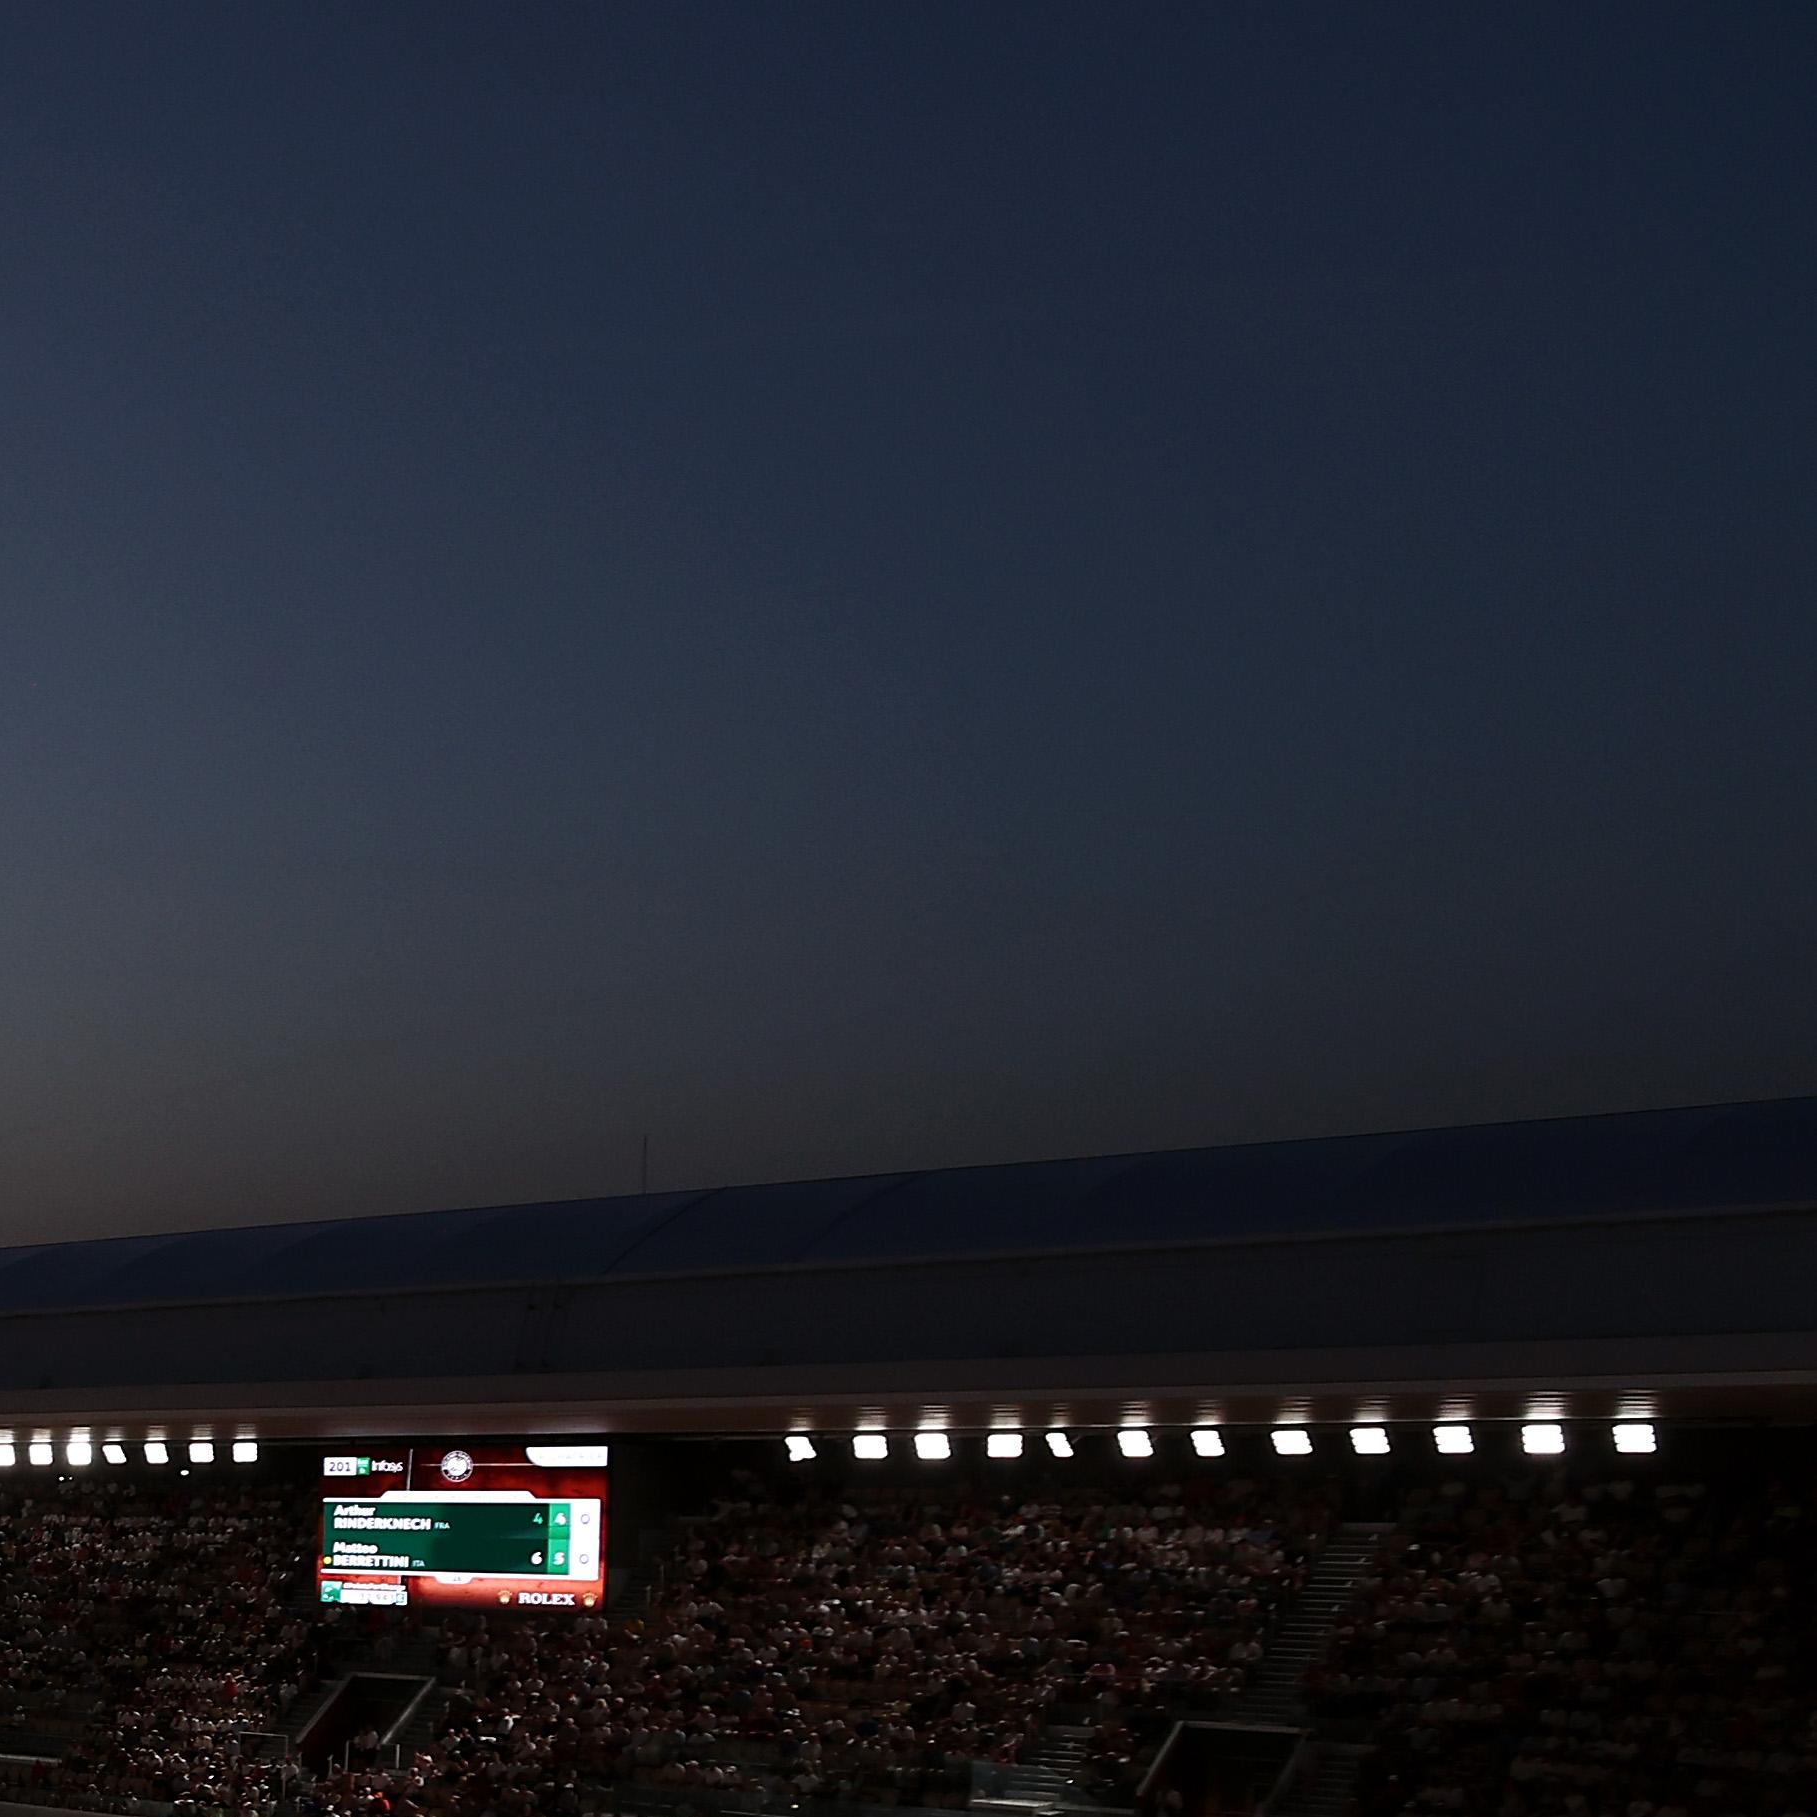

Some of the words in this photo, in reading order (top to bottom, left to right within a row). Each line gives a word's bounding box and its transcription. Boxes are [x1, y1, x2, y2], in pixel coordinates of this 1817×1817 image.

[328, 1461, 352, 1473] 201
[332, 1504, 376, 1517] Arthur
[333, 1516, 432, 1531] RINDERKNECH
[433, 1521, 451, 1530] FRA
[532, 1512, 543, 1525] 4
[332, 1542, 379, 1554] Matteo
[332, 1555, 410, 1568] BERRETTINI
[531, 1551, 543, 1565] 6
[517, 1592, 576, 1606] ROLEX
